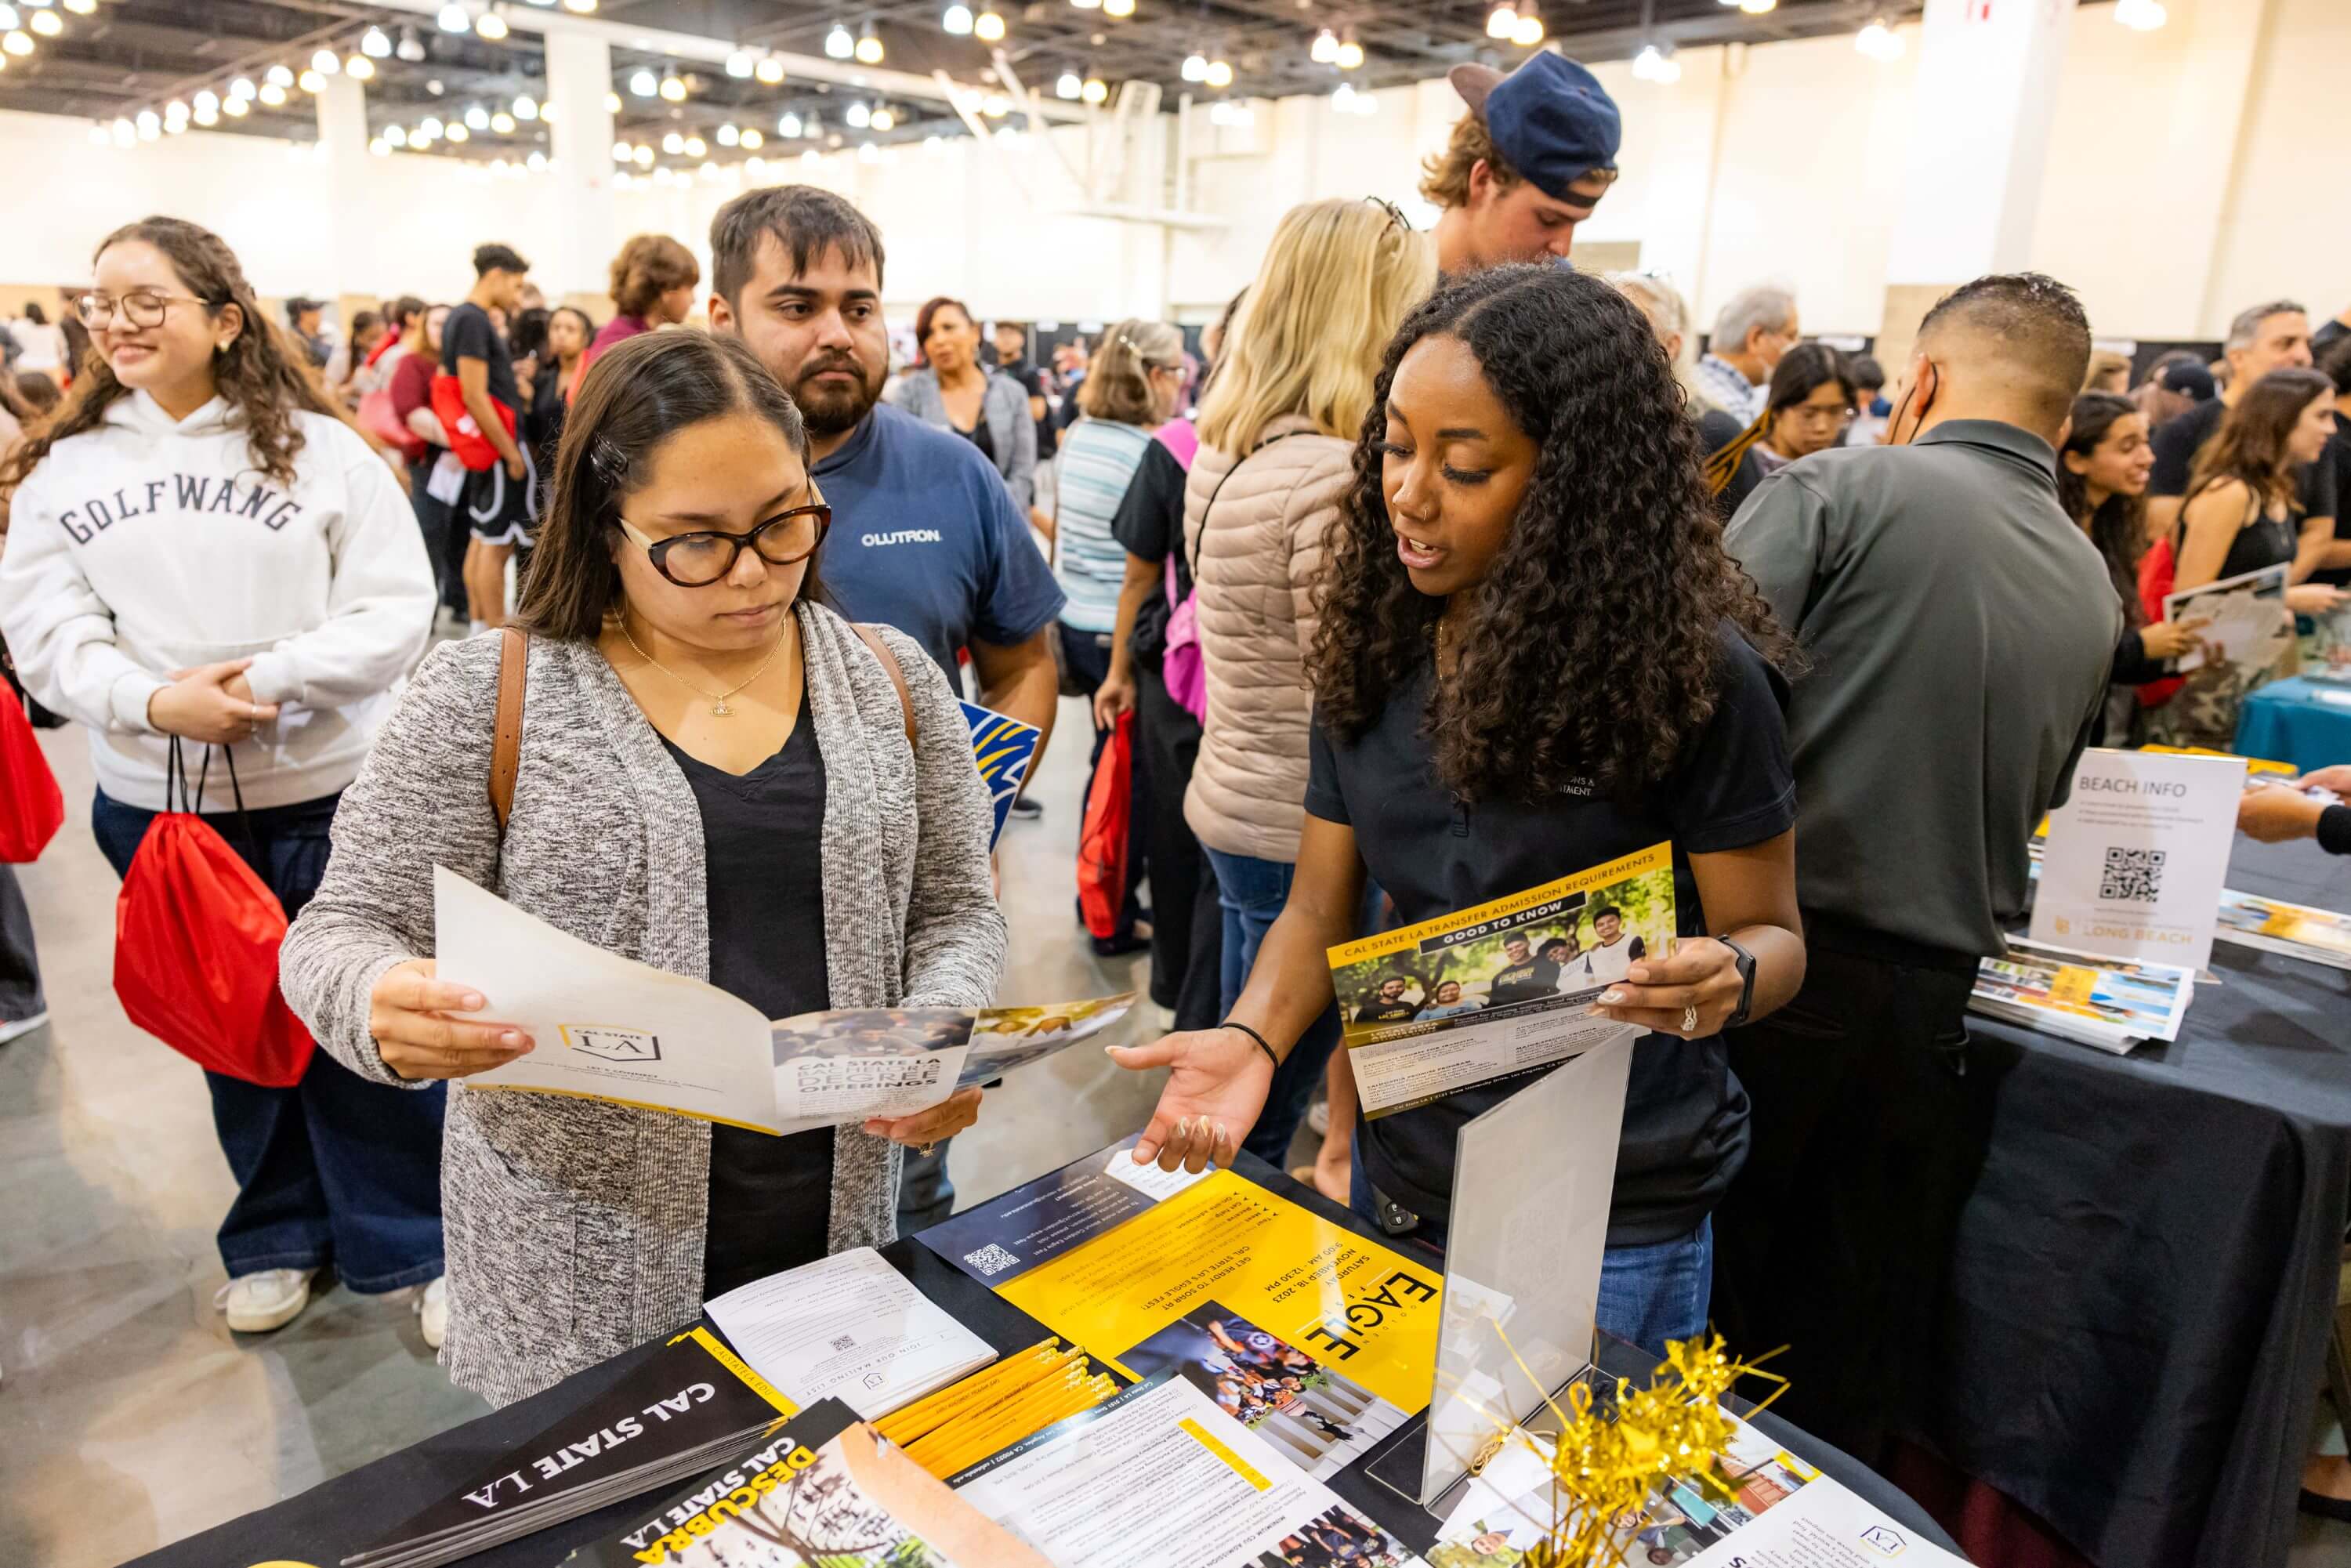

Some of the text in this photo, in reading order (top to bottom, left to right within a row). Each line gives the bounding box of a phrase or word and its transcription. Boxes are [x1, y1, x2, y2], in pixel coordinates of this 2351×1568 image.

[2079, 777, 2186, 798] BEACH INFO
[1344, 853, 1655, 958] CAL STATE LA TRANSFER ADMISSION REQUIREMENTS
[1444, 900, 1562, 944] GOOD TO KNOW
[2083, 924, 2128, 940] LONG
[2135, 929, 2193, 944] BEACH
[581, 1035, 647, 1055] LA
[798, 1061, 839, 1070] CAL
[798, 1064, 940, 1077] BACHELOR'S
[798, 1070, 940, 1088] DEGREE
[799, 1079, 938, 1093] OFFERINGS
[1322, 1241, 1343, 1255] 9:00
[1307, 1254, 1324, 1265] AM
[1139, 1245, 1251, 1311] CAL STATE LA'S EAGLE FEST!
[1270, 1248, 1357, 1303] NOVEMBER 18, 2023
[1278, 1266, 1304, 1282] 12:30
[1325, 1255, 1371, 1286] SATURDAY
[1159, 1255, 1252, 1311] GET READY TO SOAR AT
[1262, 1280, 1282, 1292] PM
[1304, 1272, 1439, 1361] EAGLE
[873, 1353, 894, 1364] OUR
[897, 1342, 922, 1356] JOIN
[712, 1345, 772, 1397] CALSTATELA.EDU
[826, 1361, 872, 1384] MAILING
[803, 1382, 826, 1396] LIST
[1129, 1385, 1145, 1395] State
[1106, 1399, 1121, 1407] 5151
[462, 1382, 715, 1509] CAL STATE LA
[1021, 1433, 1046, 1447] Angeles,
[994, 1450, 1015, 1462] 90032
[620, 1436, 796, 1550] CAL STATE LA
[632, 1444, 817, 1566] DESCUBRA
[1204, 1515, 1287, 1568] MINIMUM CSU ADMISSION
